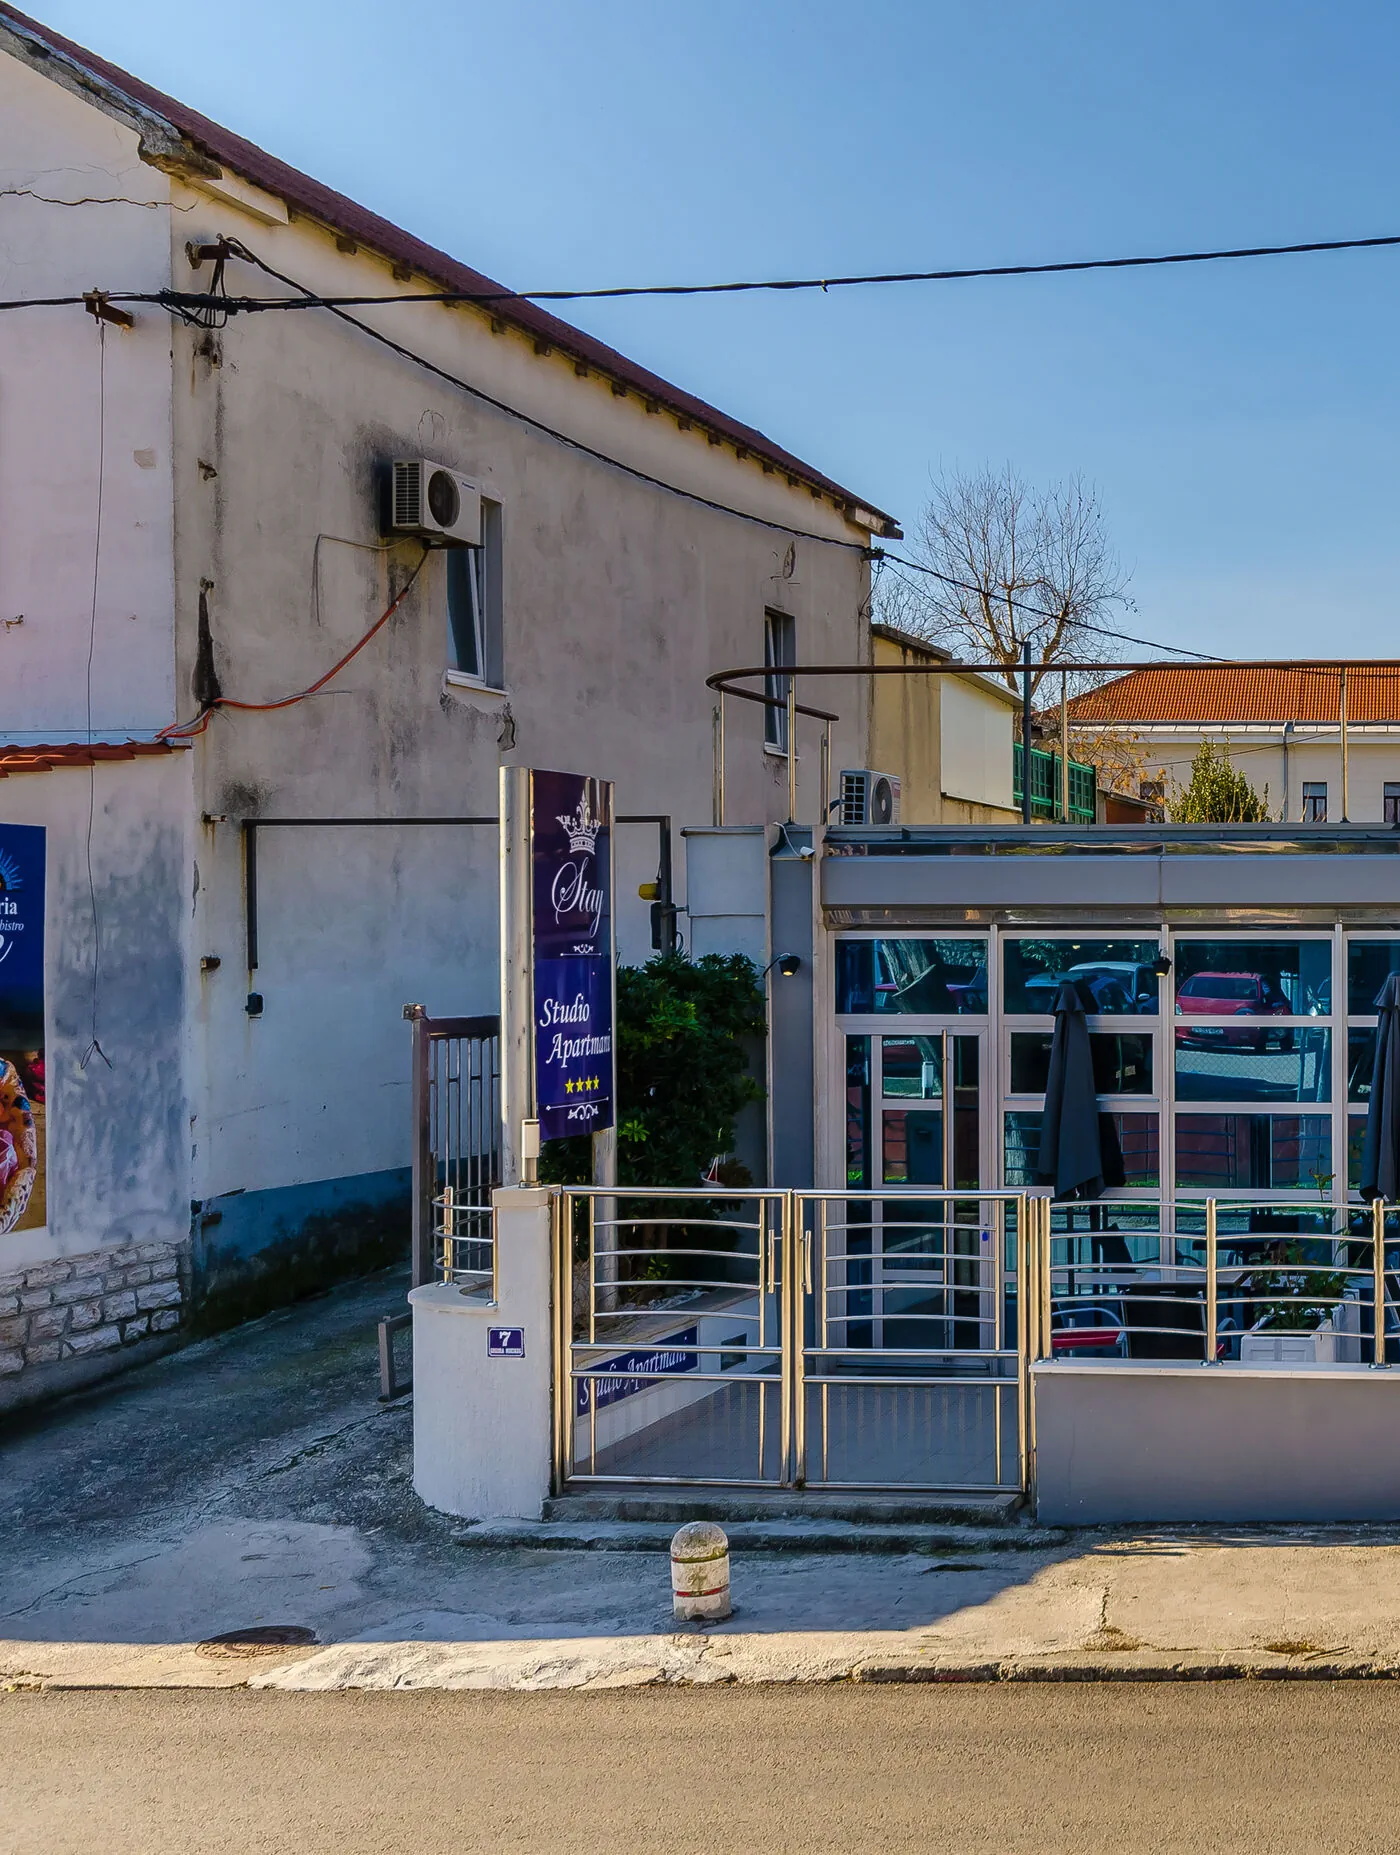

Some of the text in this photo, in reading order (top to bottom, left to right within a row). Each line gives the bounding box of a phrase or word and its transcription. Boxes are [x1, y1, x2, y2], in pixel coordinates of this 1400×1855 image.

[551, 857, 604, 938] Stay
[539, 993, 590, 1027] Studio
[545, 1027, 611, 1068] Apartmani
[499, 1331, 511, 1347] 7
[580, 1362, 622, 1405] Sudio
